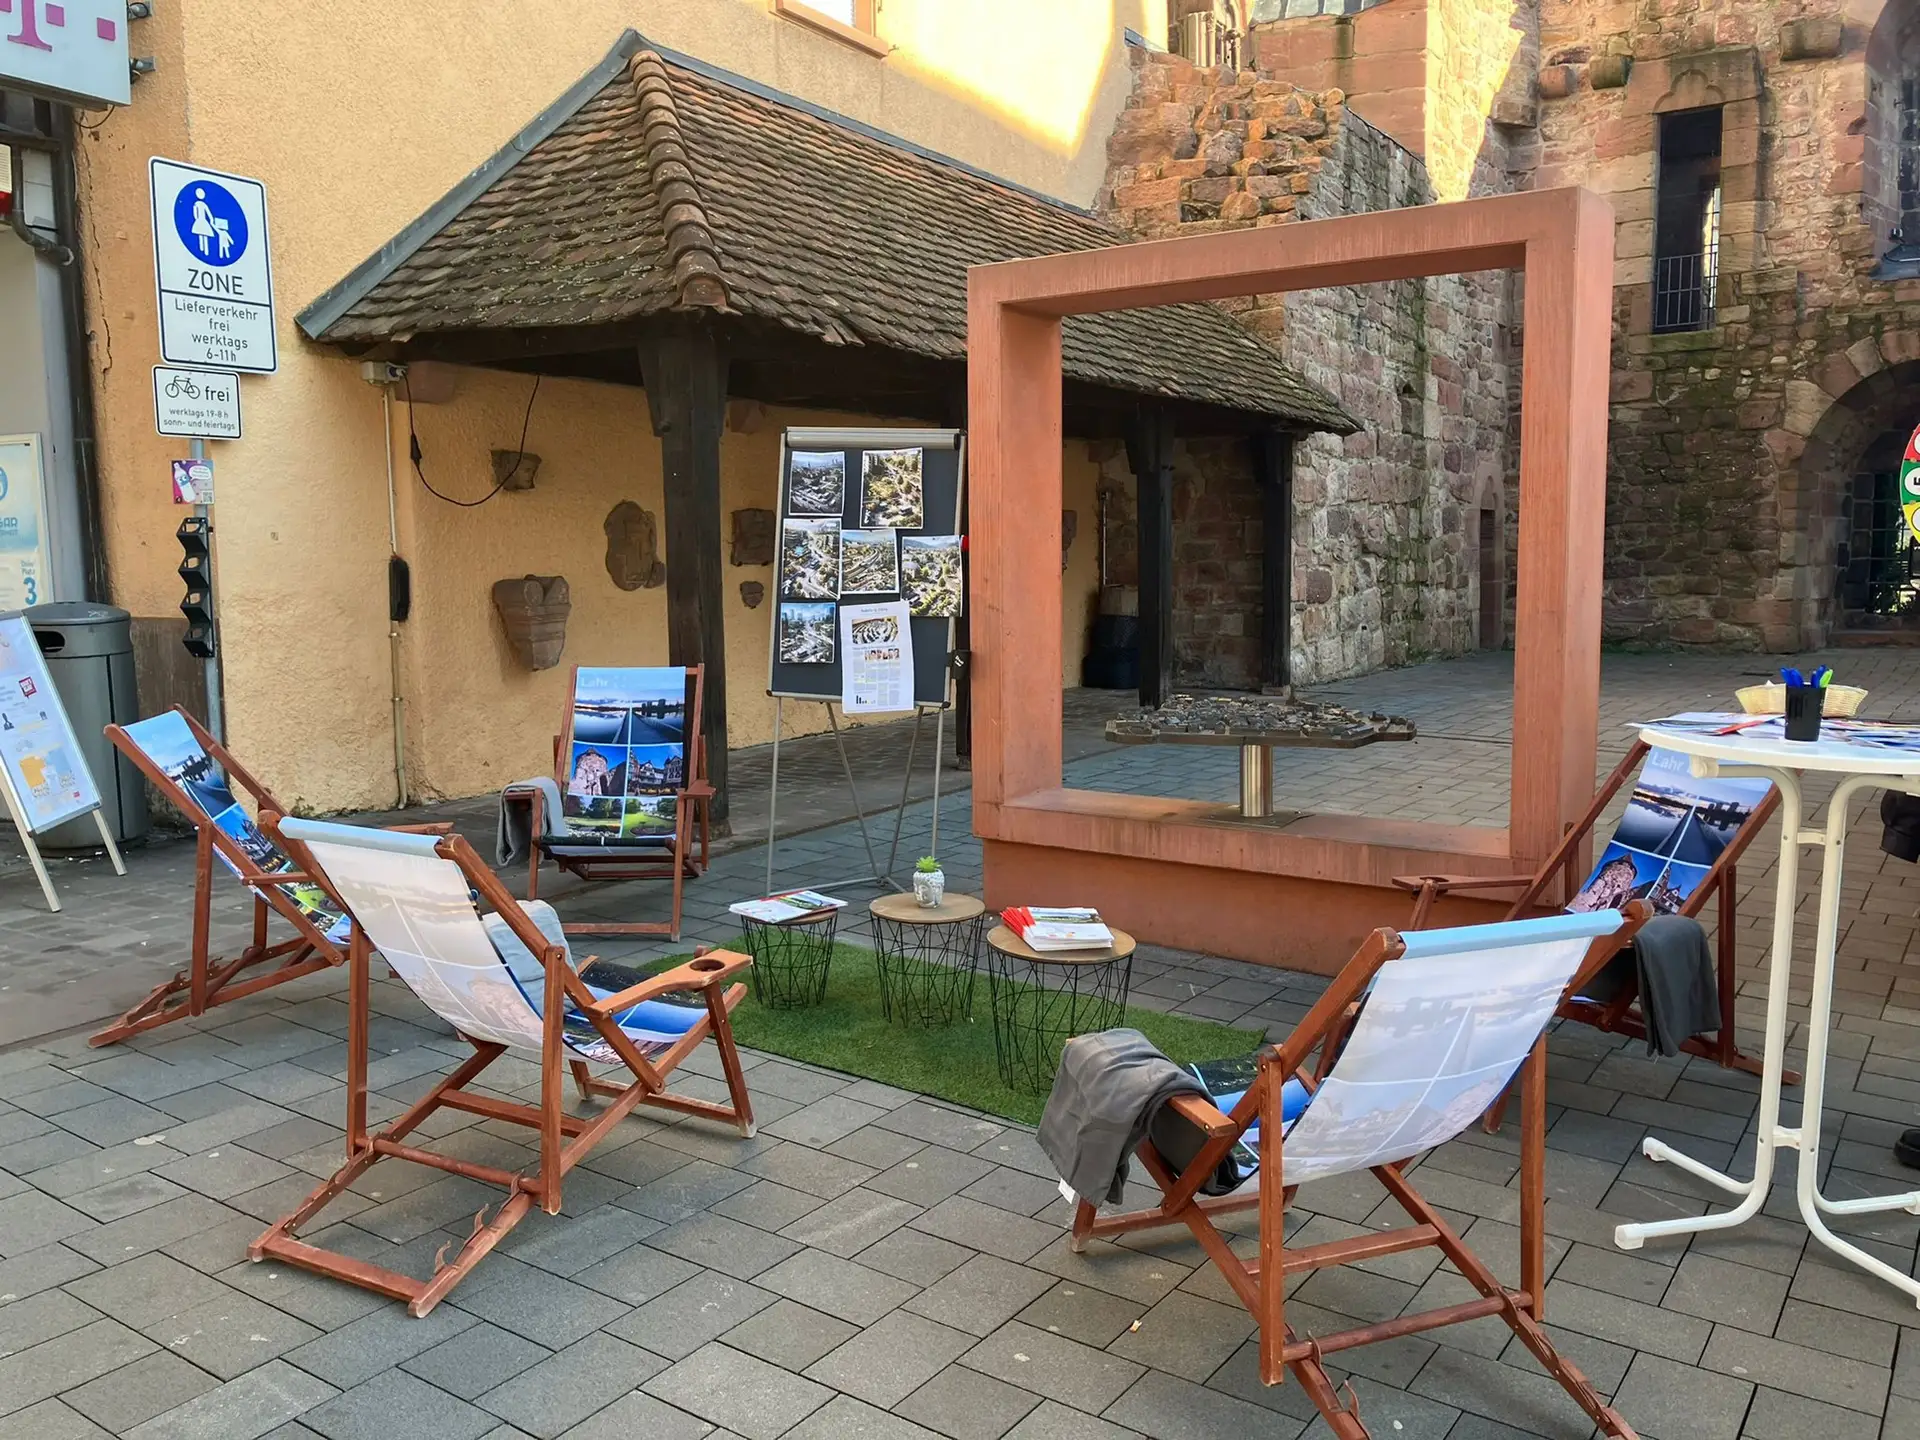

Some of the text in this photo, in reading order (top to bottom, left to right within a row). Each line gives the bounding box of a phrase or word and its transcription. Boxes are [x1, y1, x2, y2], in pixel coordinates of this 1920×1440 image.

[187, 268, 245, 296] ZONE
[174, 298, 258, 321] Lieferverkehr
[209, 318, 230, 332] frei
[191, 333, 248, 351] werktags
[204, 386, 230, 403] frei
[169, 408, 205, 418] werktags
[163, 418, 236, 432] sonn- und feiertags
[23, 576, 37, 605] 3
[1651, 751, 1685, 772] Lahr
